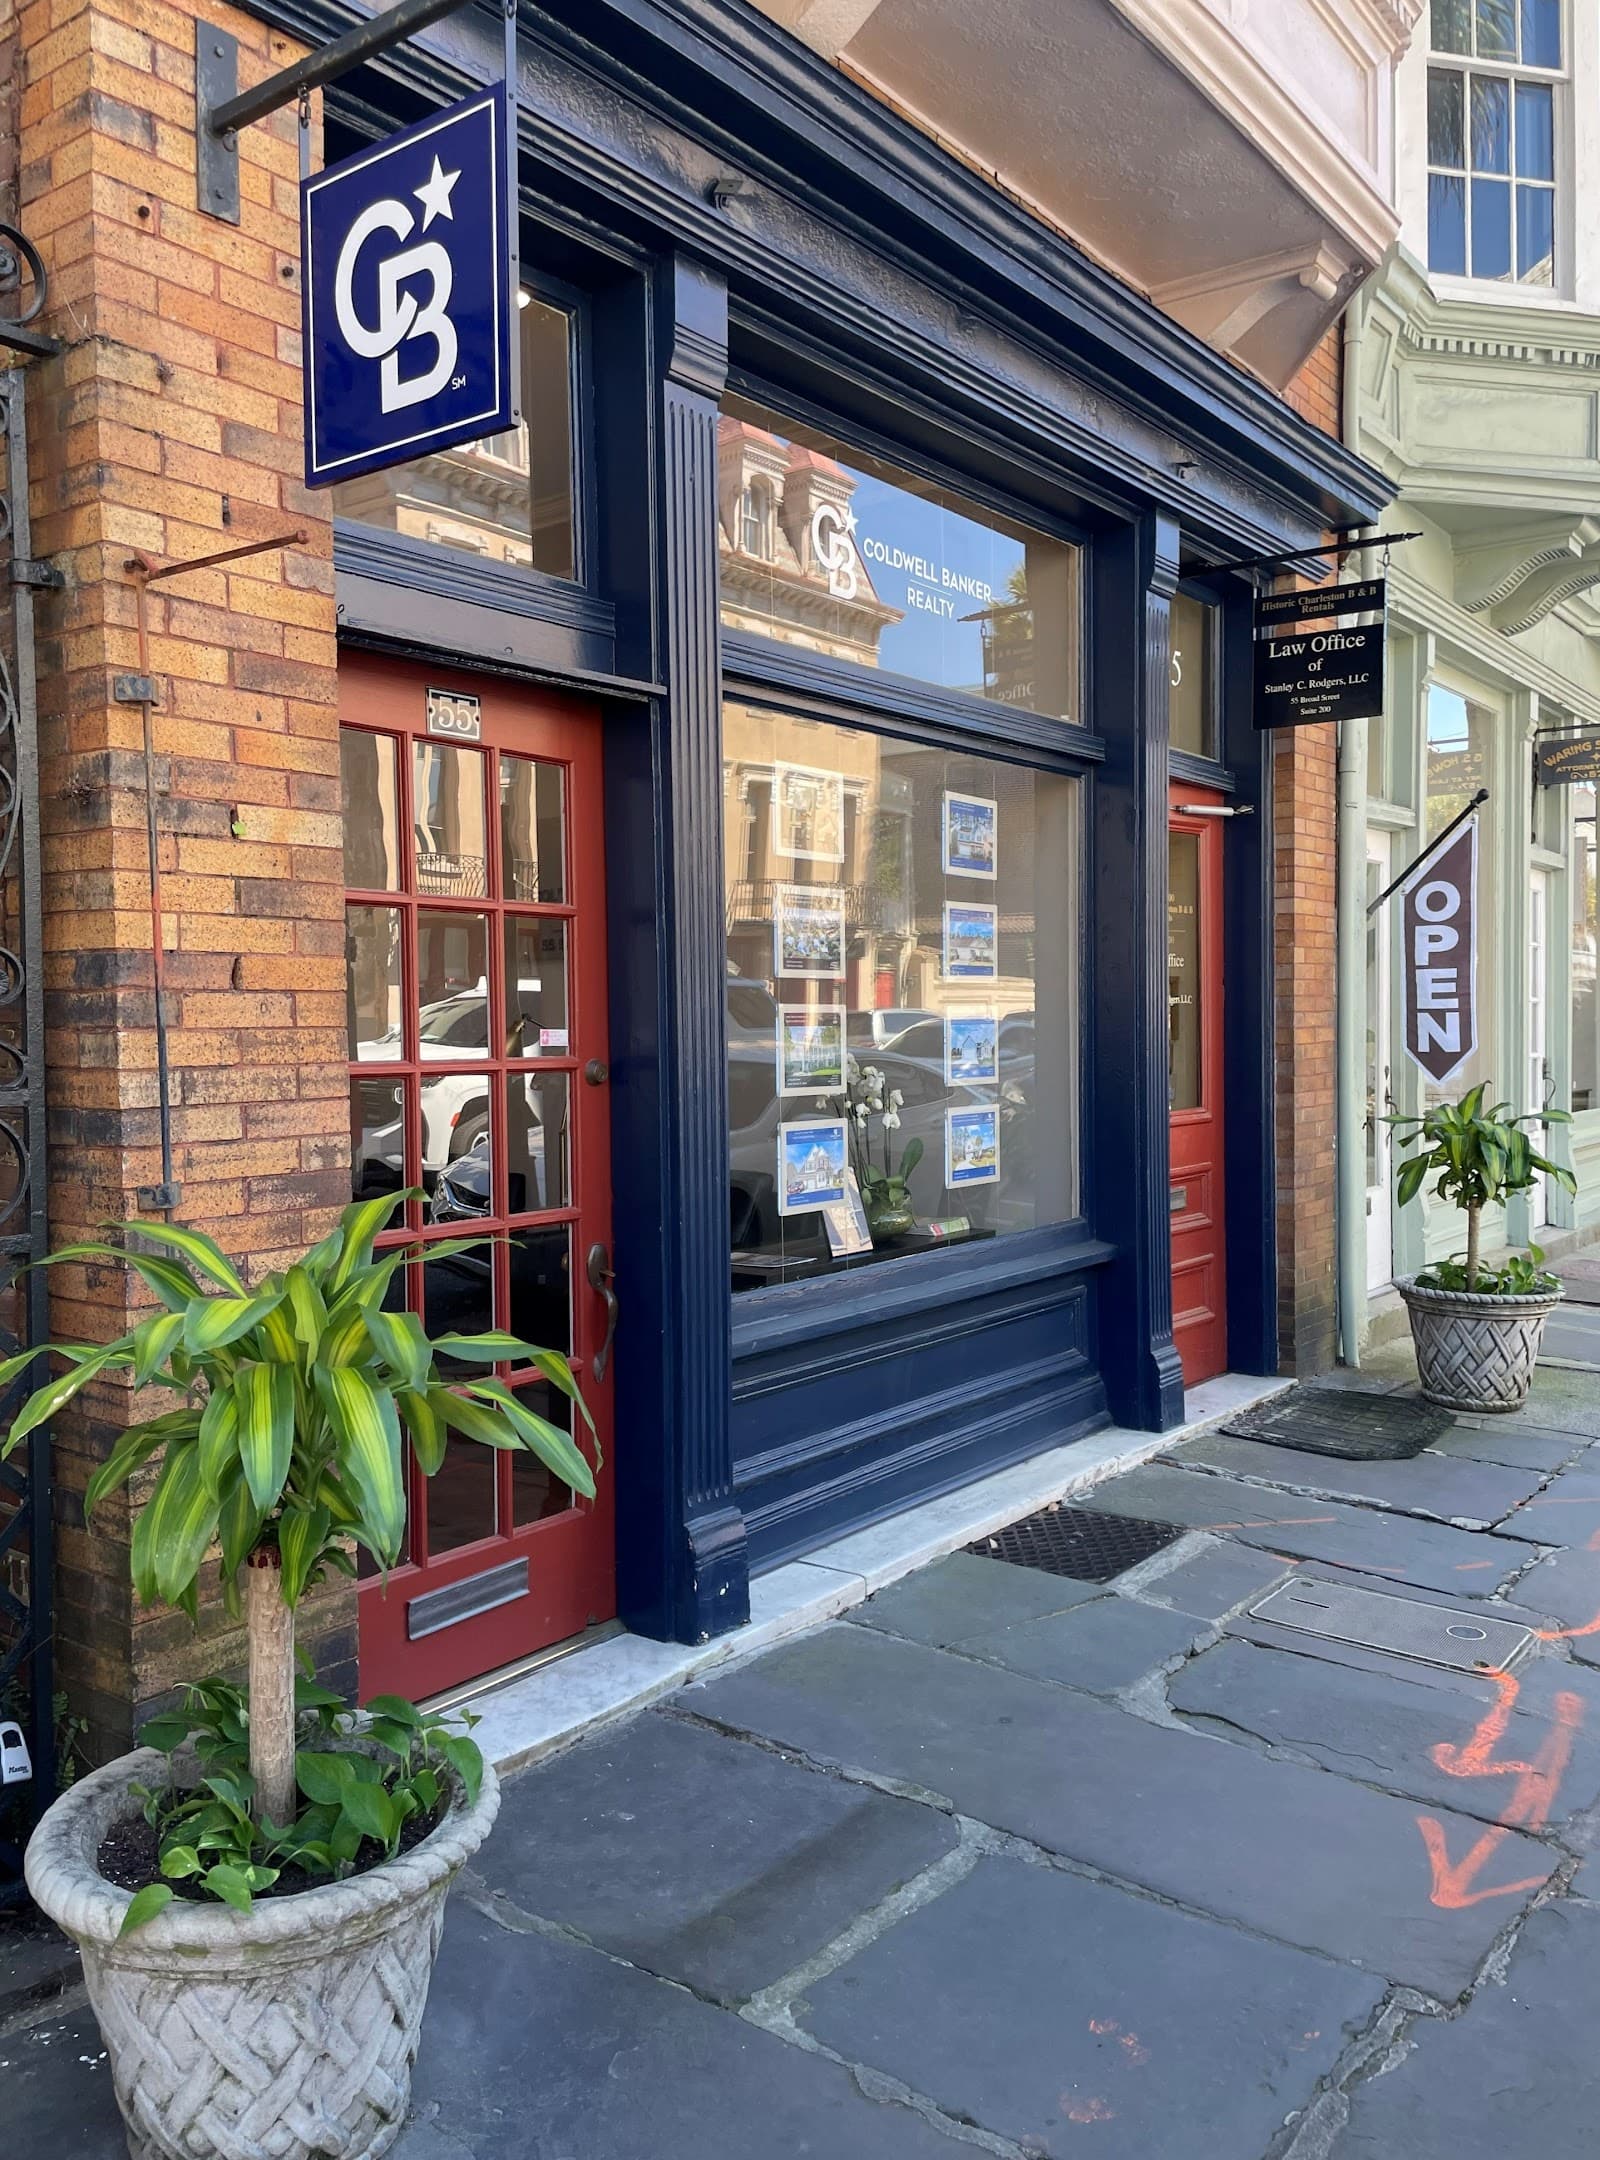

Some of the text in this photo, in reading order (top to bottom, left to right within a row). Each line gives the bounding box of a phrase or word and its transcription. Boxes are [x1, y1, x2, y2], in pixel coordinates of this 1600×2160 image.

[451, 374, 466, 390] SM
[863, 538, 992, 602] COLDWELL BANKER
[907, 587, 955, 618] REALTY
[1262, 586, 1376, 612] Historic Charleston B & B
[1301, 601, 1335, 614] Rentals
[1269, 634, 1366, 659] Law Office
[1308, 658, 1324, 672] of
[1264, 673, 1369, 694] Stanley C. Rodgers, LLC
[1290, 693, 1341, 705] 55 Broad Street
[439, 696, 472, 731] 55
[1300, 707, 1317, 715] Suite
[1543, 742, 1592, 767] WARING
[1168, 953, 1185, 967] ffice
[1415, 880, 1461, 1052] OPEN
